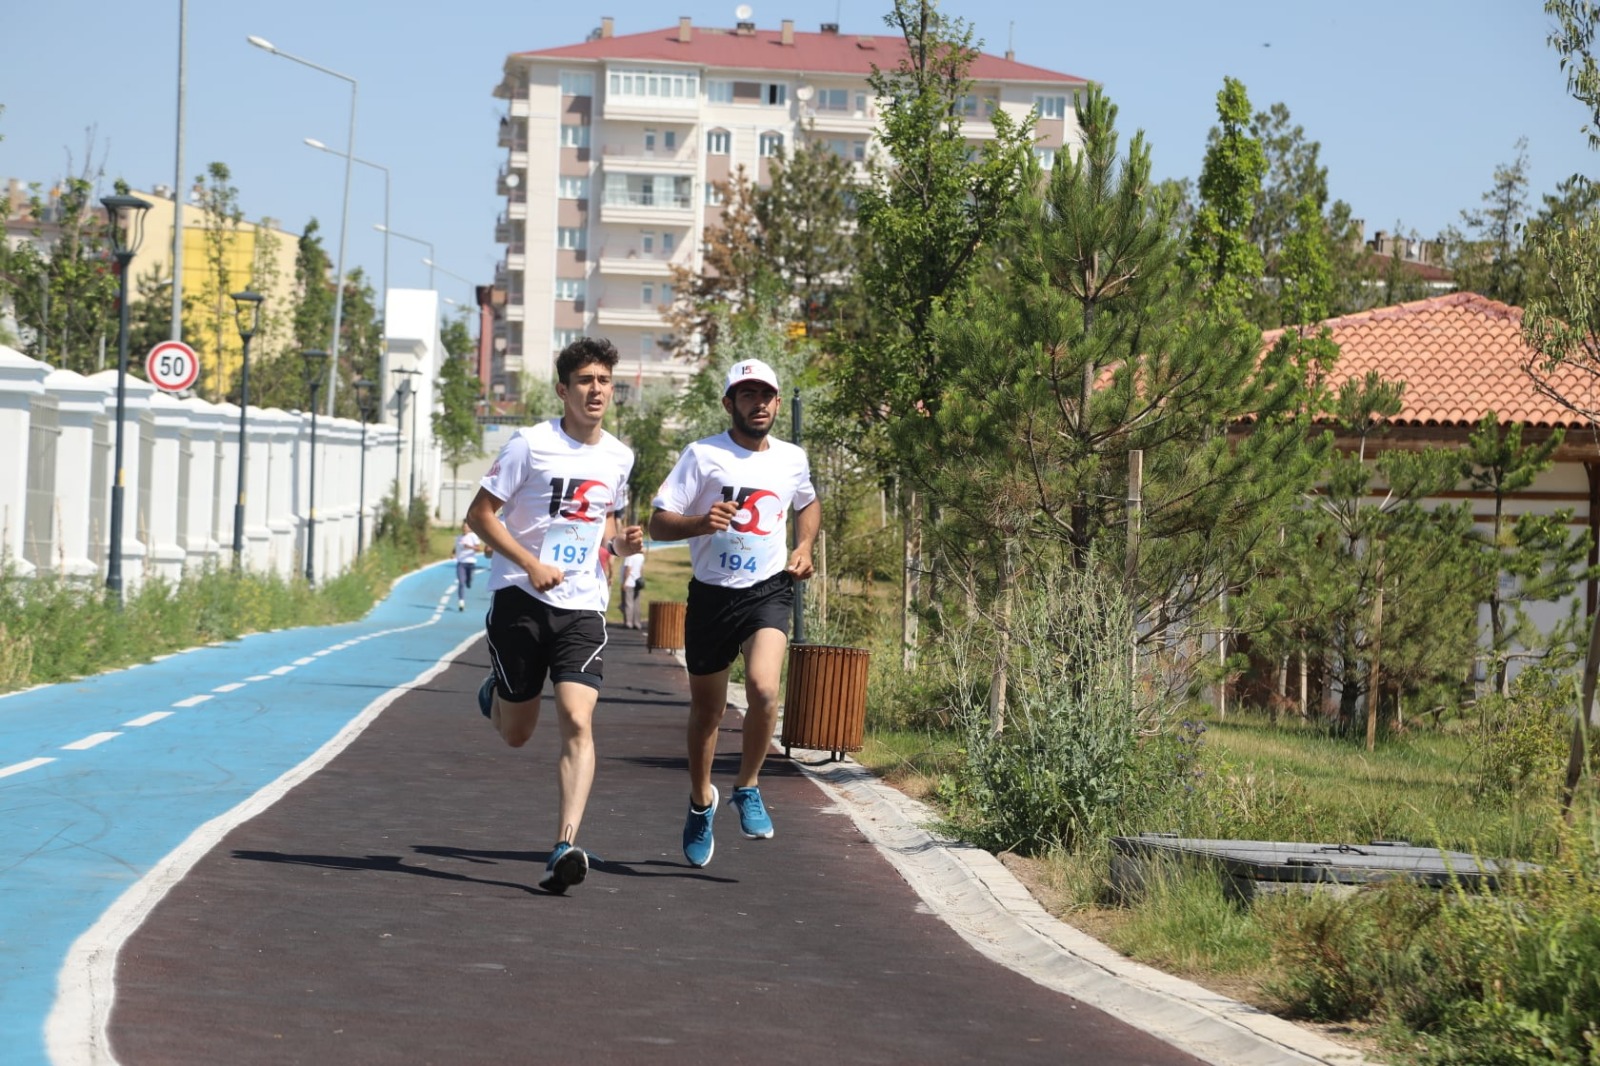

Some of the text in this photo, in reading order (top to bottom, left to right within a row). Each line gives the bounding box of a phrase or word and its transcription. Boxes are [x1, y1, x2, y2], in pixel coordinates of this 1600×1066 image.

[160, 356, 184, 376] 50
[742, 365, 753, 376] 15
[552, 543, 588, 565] 193
[720, 551, 757, 573] 194
